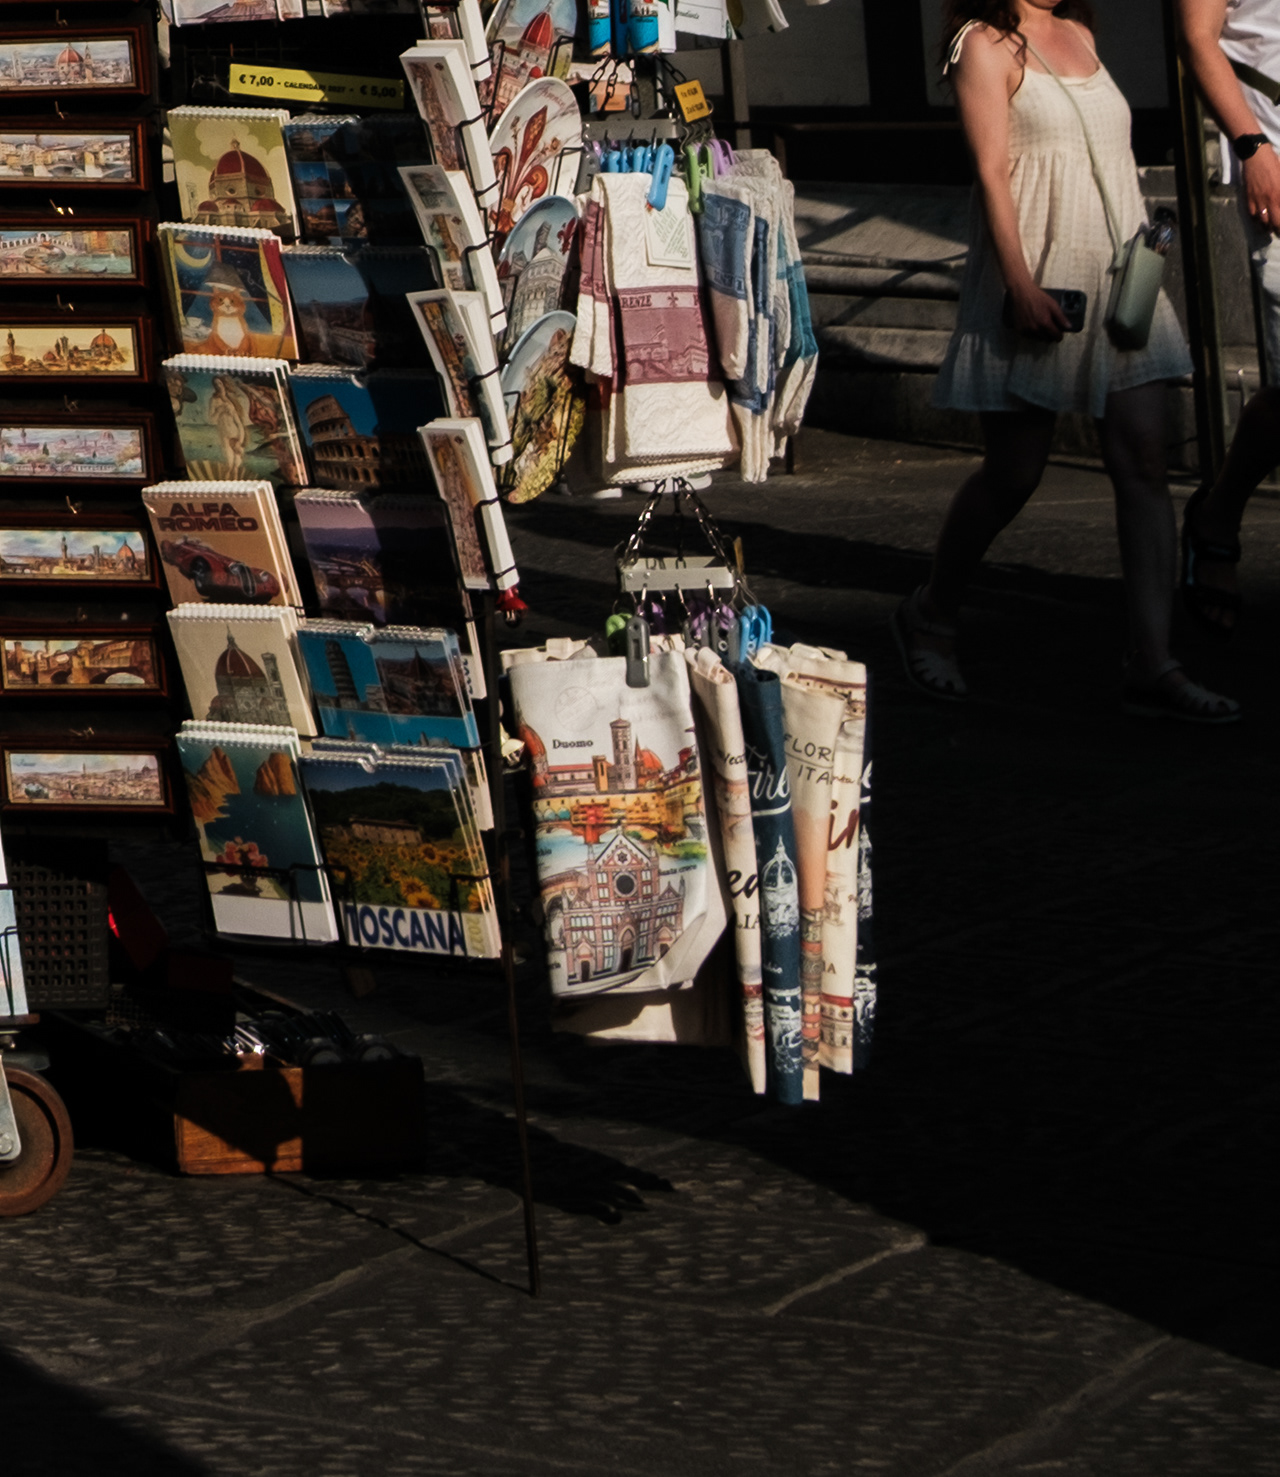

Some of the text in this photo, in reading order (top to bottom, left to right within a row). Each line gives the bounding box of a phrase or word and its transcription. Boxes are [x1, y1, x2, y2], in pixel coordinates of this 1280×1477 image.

[238, 74, 247, 84] €
[249, 75, 274, 86] 7,00
[360, 84, 367, 95] €
[369, 86, 396, 99] 5,00
[169, 502, 241, 517] ALFA
[158, 517, 259, 533] ROMEO
[552, 739, 594, 749] Duomo
[346, 904, 465, 952] TOSCANA
